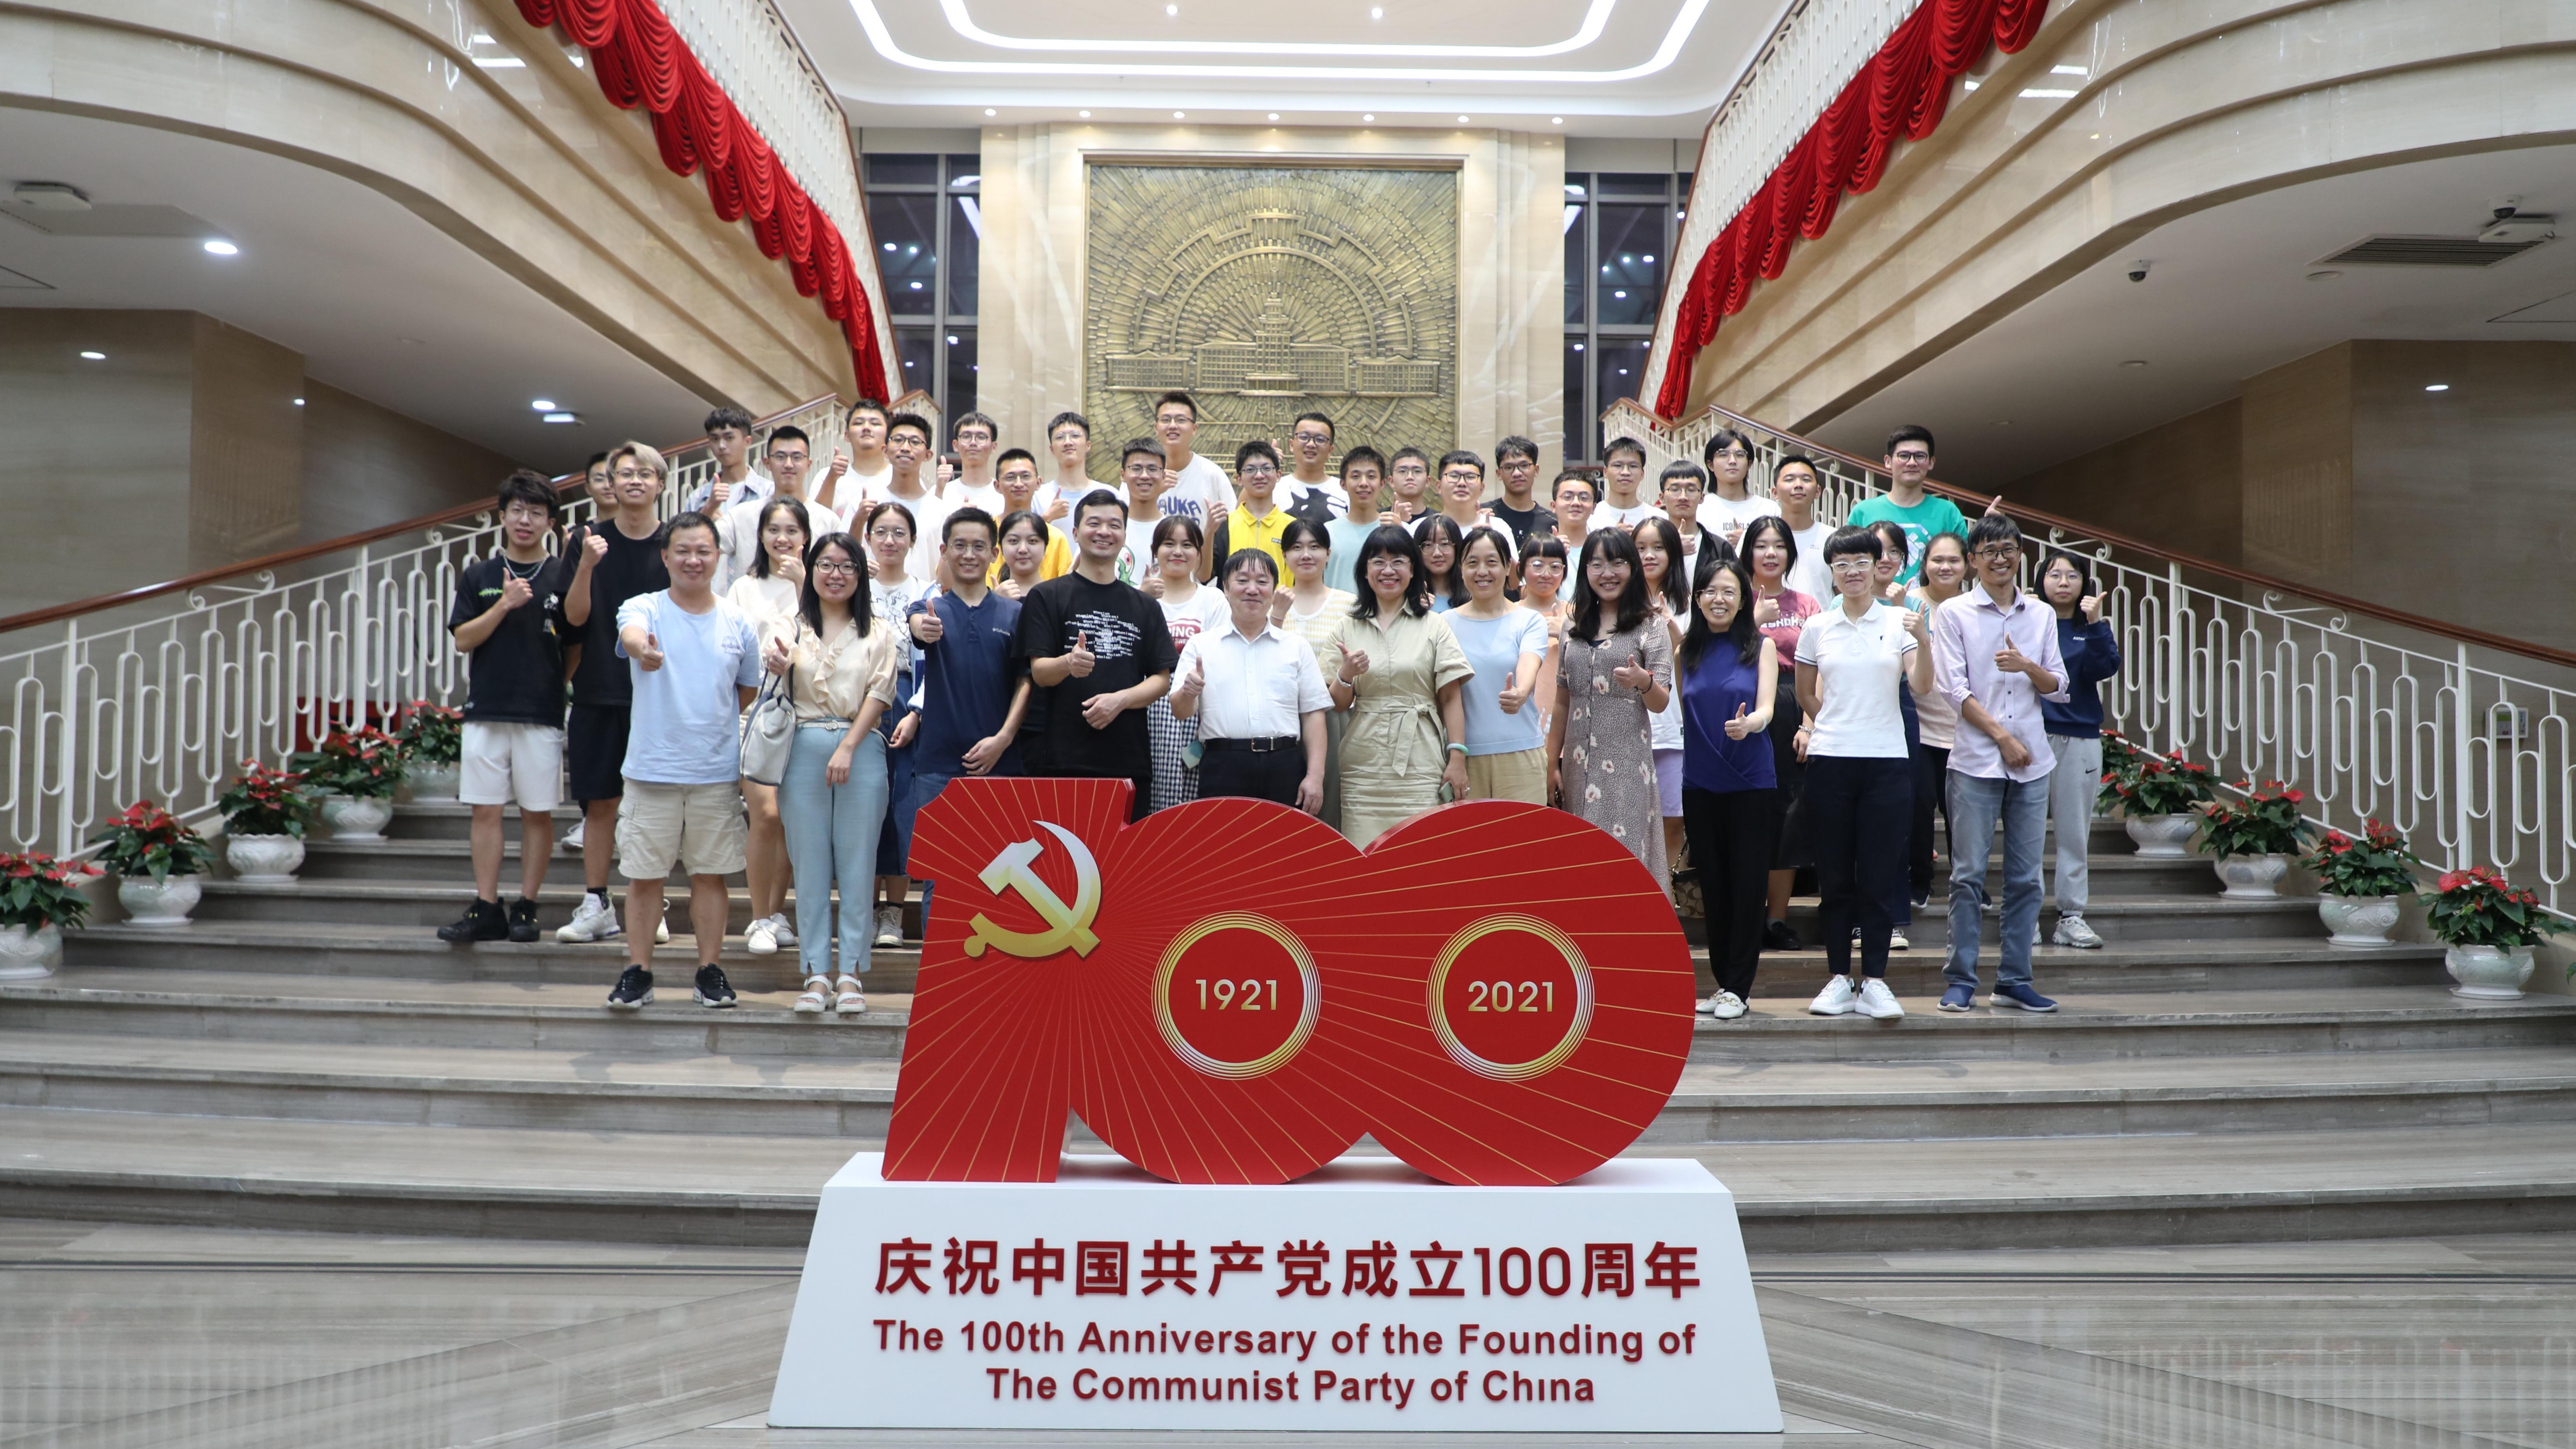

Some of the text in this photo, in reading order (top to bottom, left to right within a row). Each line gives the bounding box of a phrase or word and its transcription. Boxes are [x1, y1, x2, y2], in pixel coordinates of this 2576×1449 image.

[1196, 979, 1277, 1010] 1921
[1468, 981, 1553, 1012] 2021
[875, 1237, 1701, 1299] 庆祝中国共产党成立100周年
[873, 1320, 1696, 1363] The 100th Anniversary of the Founding of
[986, 1368, 1594, 1409] The Communist Party of China
